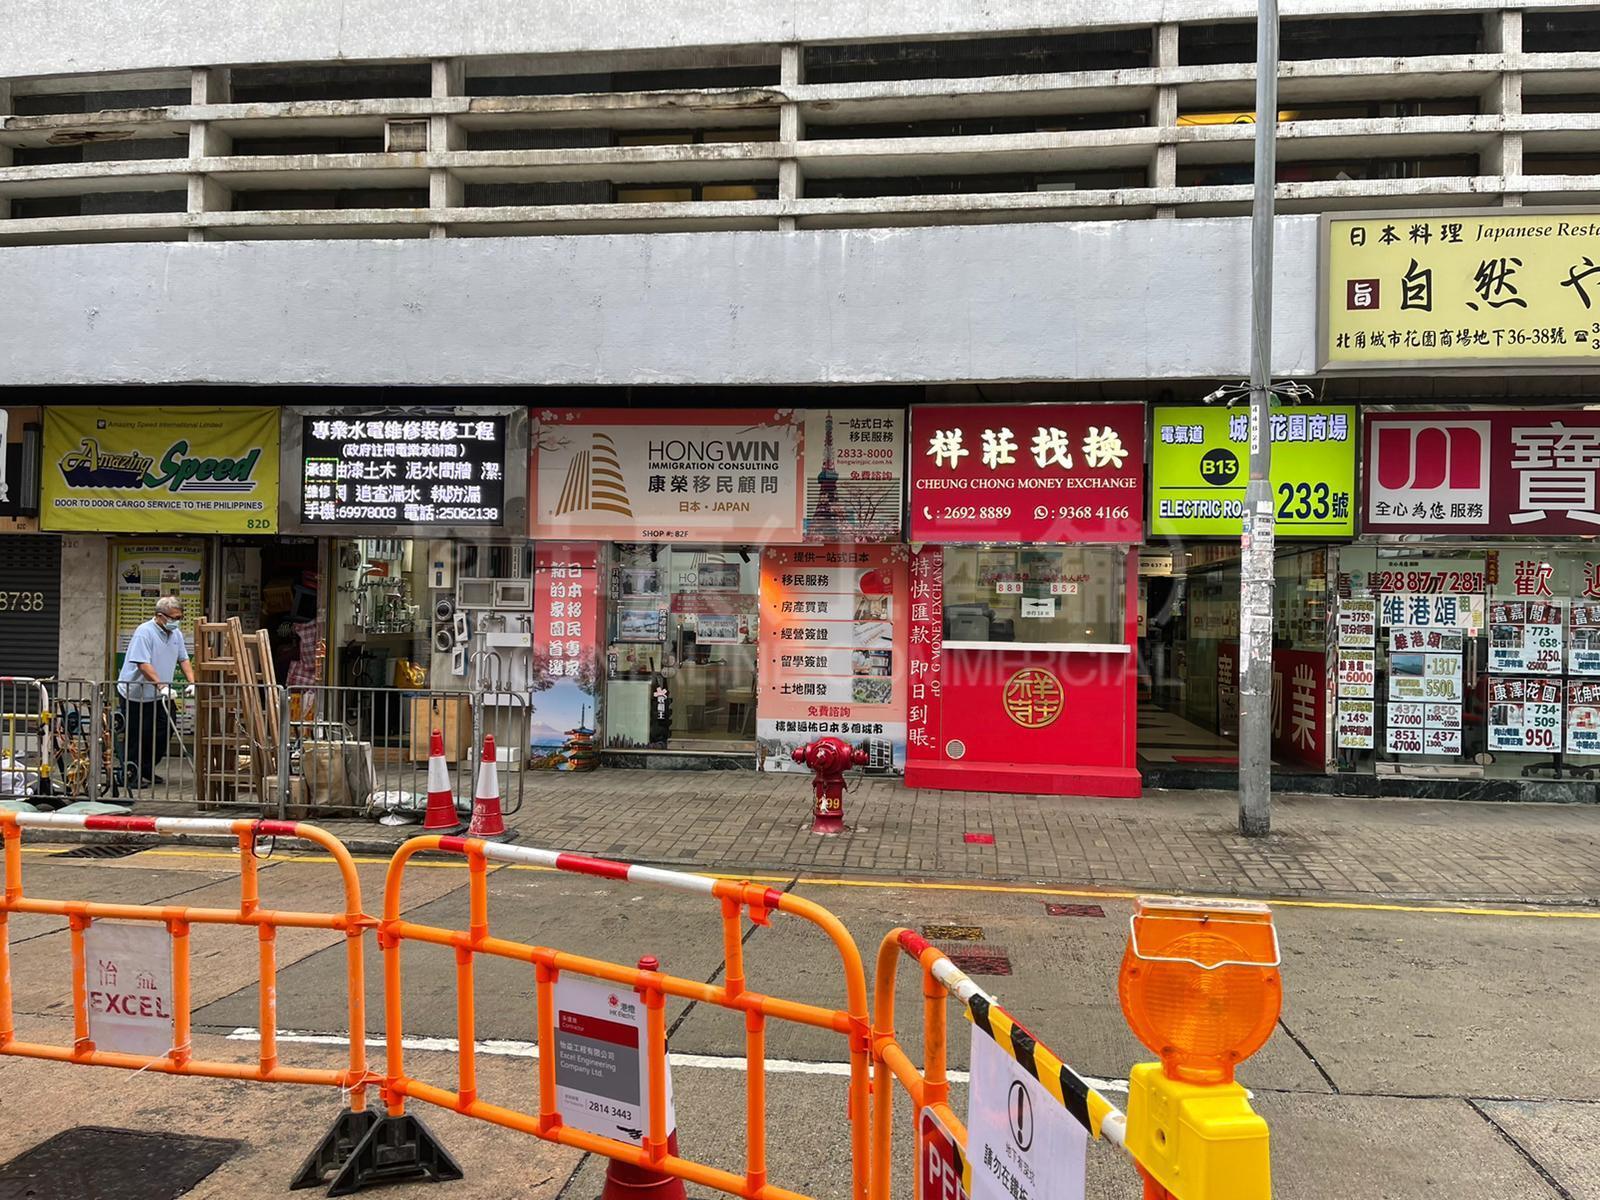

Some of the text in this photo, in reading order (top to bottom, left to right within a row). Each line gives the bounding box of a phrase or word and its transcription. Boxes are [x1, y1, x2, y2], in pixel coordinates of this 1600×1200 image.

[1350, 223, 1464, 247] 日本料理
[1476, 224, 1552, 242] Japanese
[839, 418, 894, 429] 一站式日本
[1229, 413, 1349, 441] 城花園商場
[312, 421, 495, 441] 專業水電維修裝修工程
[849, 431, 894, 442] 移民服務
[1160, 424, 1204, 444] 電氣道
[648, 440, 780, 462] HONGWIN
[837, 449, 893, 458] 2833-8000
[927, 426, 1129, 470] 祥莊找換
[61, 438, 261, 492] Amazing Speed
[648, 462, 780, 471] IMMIGRATION CONSULTING
[1202, 459, 1236, 475] B13
[648, 474, 779, 495] 康榮移民顧問
[916, 477, 1137, 489] CHEUNG CHONG MONEY EXCHANGE
[55, 500, 78, 508] DOOR
[79, 500, 90, 508] TO
[92, 500, 114, 508] DOOR
[116, 500, 145, 508] CARGO
[147, 501, 181, 509] SERVICE
[197, 501, 212, 509] THE
[678, 501, 750, 512] 日本 JAPAN
[1159, 499, 1222, 519] ELECTRIC
[1375, 501, 1484, 520] 全心為您服務
[944, 506, 1129, 519] 2692 8889 9368 4166
[247, 519, 271, 529] 82D
[642, 530, 664, 538] SHOP
[675, 530, 689, 538] 82F
[793, 552, 870, 563] 提供一站式日本
[781, 574, 829, 587] 移民服務
[909, 556, 931, 645] 特快匯款
[781, 601, 828, 614] 房產買賣
[1382, 595, 1457, 626] 維港頌
[780, 627, 828, 641] 經營簽證
[1531, 626, 1551, 637] 773
[1539, 638, 1558, 649] 658
[780, 655, 828, 668] 留學簽證
[780, 682, 828, 696] 土地開發
[807, 705, 851, 718] 免費諮詢
[1534, 704, 1557, 715] 734
[1346, 713, 1366, 723] 149
[1534, 717, 1556, 727] 509
[1394, 730, 1417, 740] 851
[1432, 731, 1456, 742] 437
[90, 991, 170, 1019] EXCEL
[559, 1050, 617, 1073] Excel Engineering
[559, 1060, 591, 1076] Company
[589, 1100, 609, 1114] 2814
[611, 1106, 632, 1121] 3443
